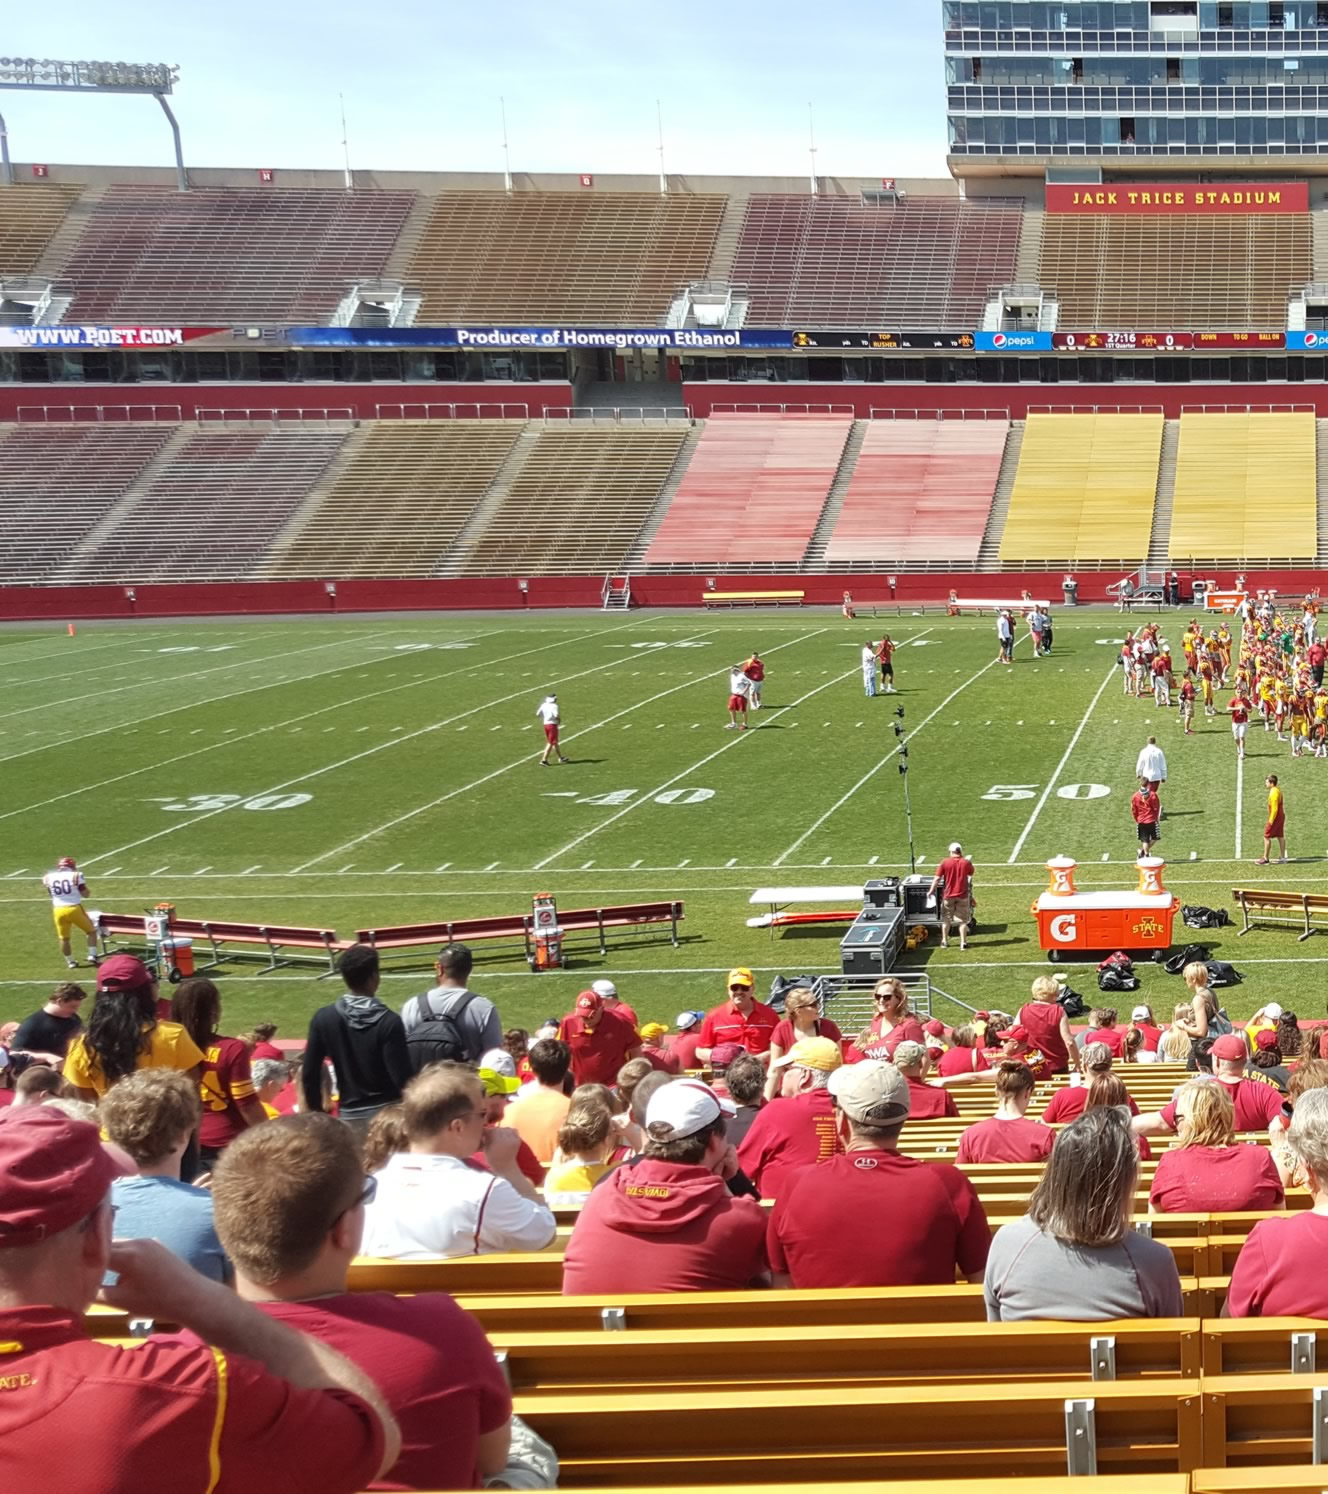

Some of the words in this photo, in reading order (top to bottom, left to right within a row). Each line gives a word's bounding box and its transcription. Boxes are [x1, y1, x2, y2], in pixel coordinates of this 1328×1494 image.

[1073, 192, 1117, 204] JACK
[1128, 192, 1185, 204] TRICE
[1195, 192, 1281, 204] STADIUM
[17, 328, 183, 346] WWW.POET.COM
[457, 330, 538, 345] Producer
[541, 330, 560, 345] of
[564, 331, 671, 348] Homegrown
[675, 331, 740, 346] Ethanol
[1007, 336, 1035, 347] pepsi
[1066, 335, 1075, 346] 0
[1107, 333, 1136, 343] 27:16
[1165, 335, 1174, 346] 0
[1201, 333, 1217, 341] DOWN
[1233, 333, 1241, 341] TO
[1241, 333, 1249, 341] GO
[1259, 333, 1271, 341] BALL
[1272, 333, 1280, 341] ON
[52, 879, 73, 896] 60
[1050, 914, 1077, 943] G
[1132, 924, 1165, 934] STATE
[1250, 1070, 1280, 1090] STATE
[0, 1373, 32, 1390] ATE
